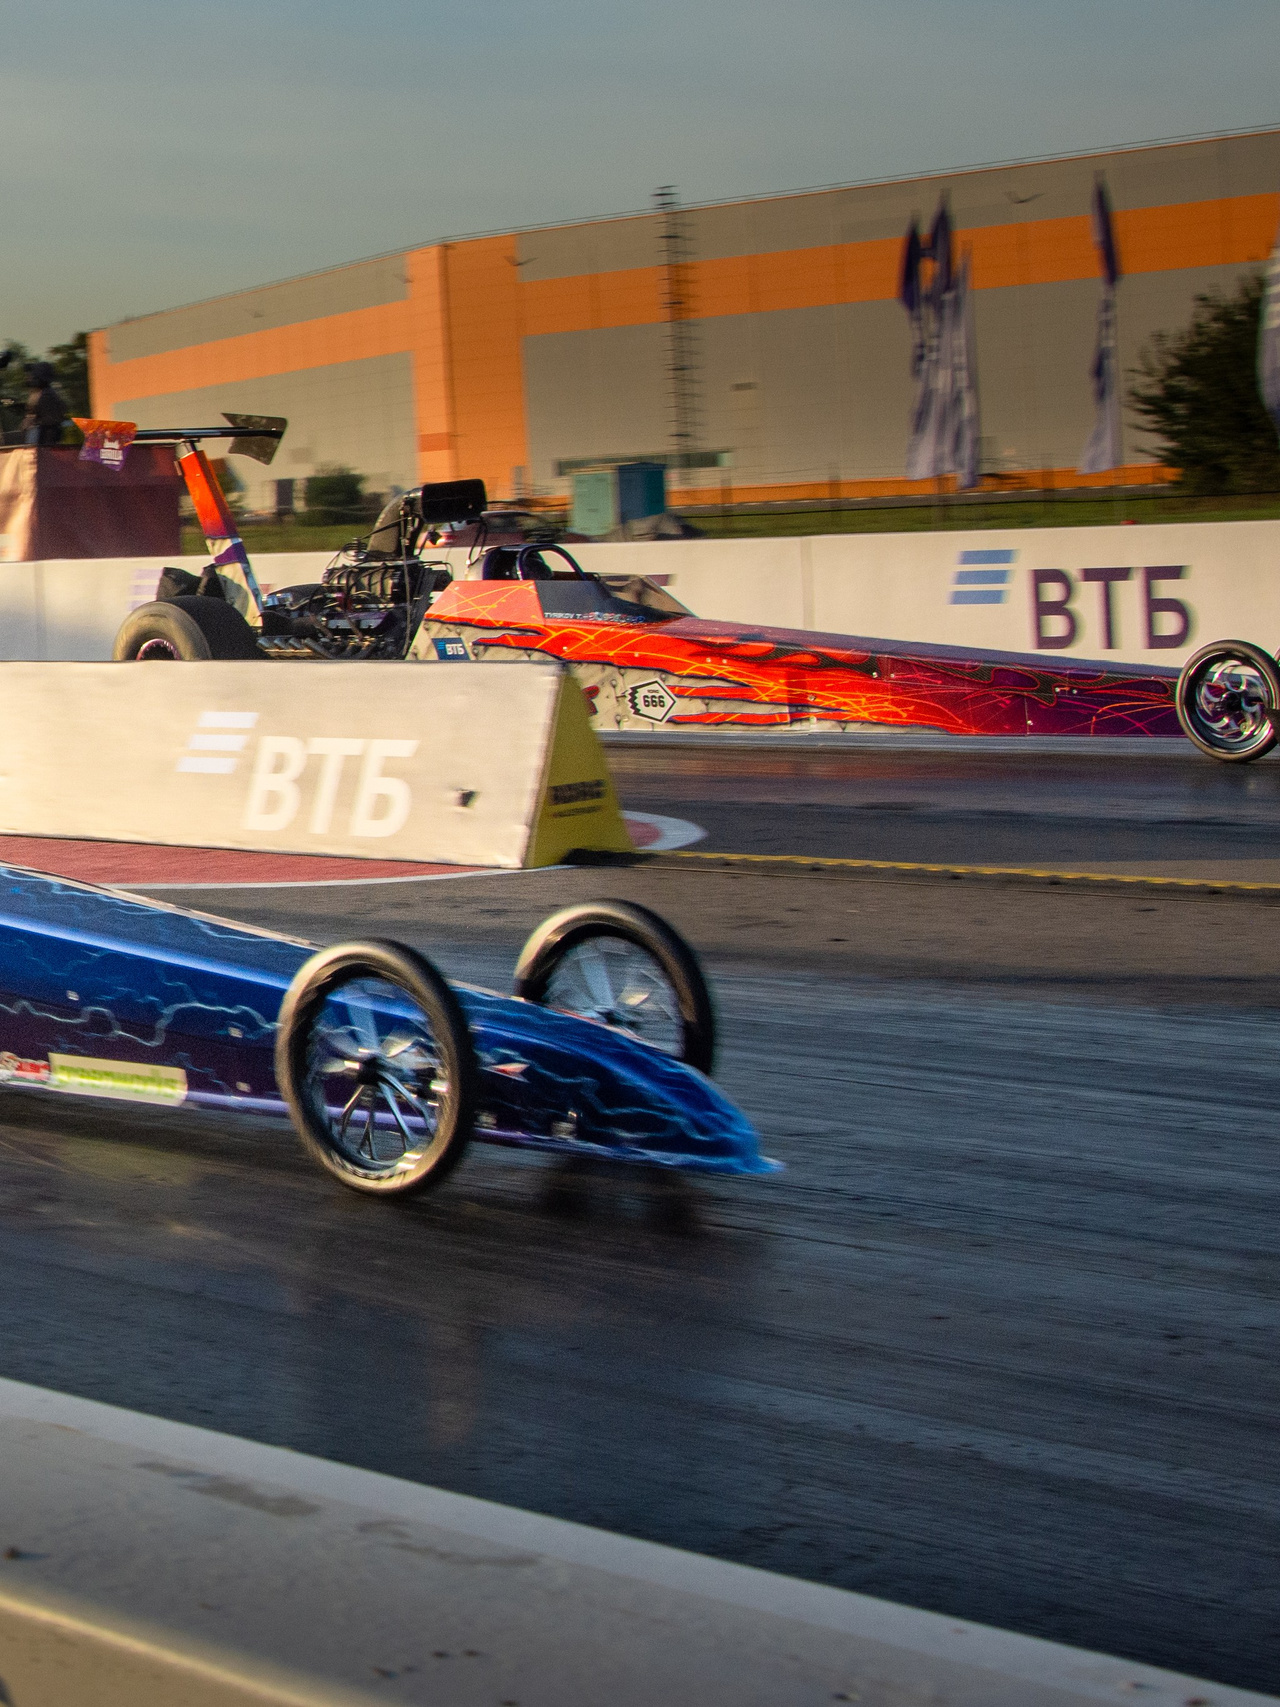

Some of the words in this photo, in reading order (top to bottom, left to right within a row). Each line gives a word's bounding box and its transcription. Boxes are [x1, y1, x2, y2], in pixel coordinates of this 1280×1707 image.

[1028, 565, 1197, 650] ВТБ
[446, 643, 465, 655] ВТБ
[642, 694, 666, 708] 666
[242, 736, 420, 838] ВТБ
